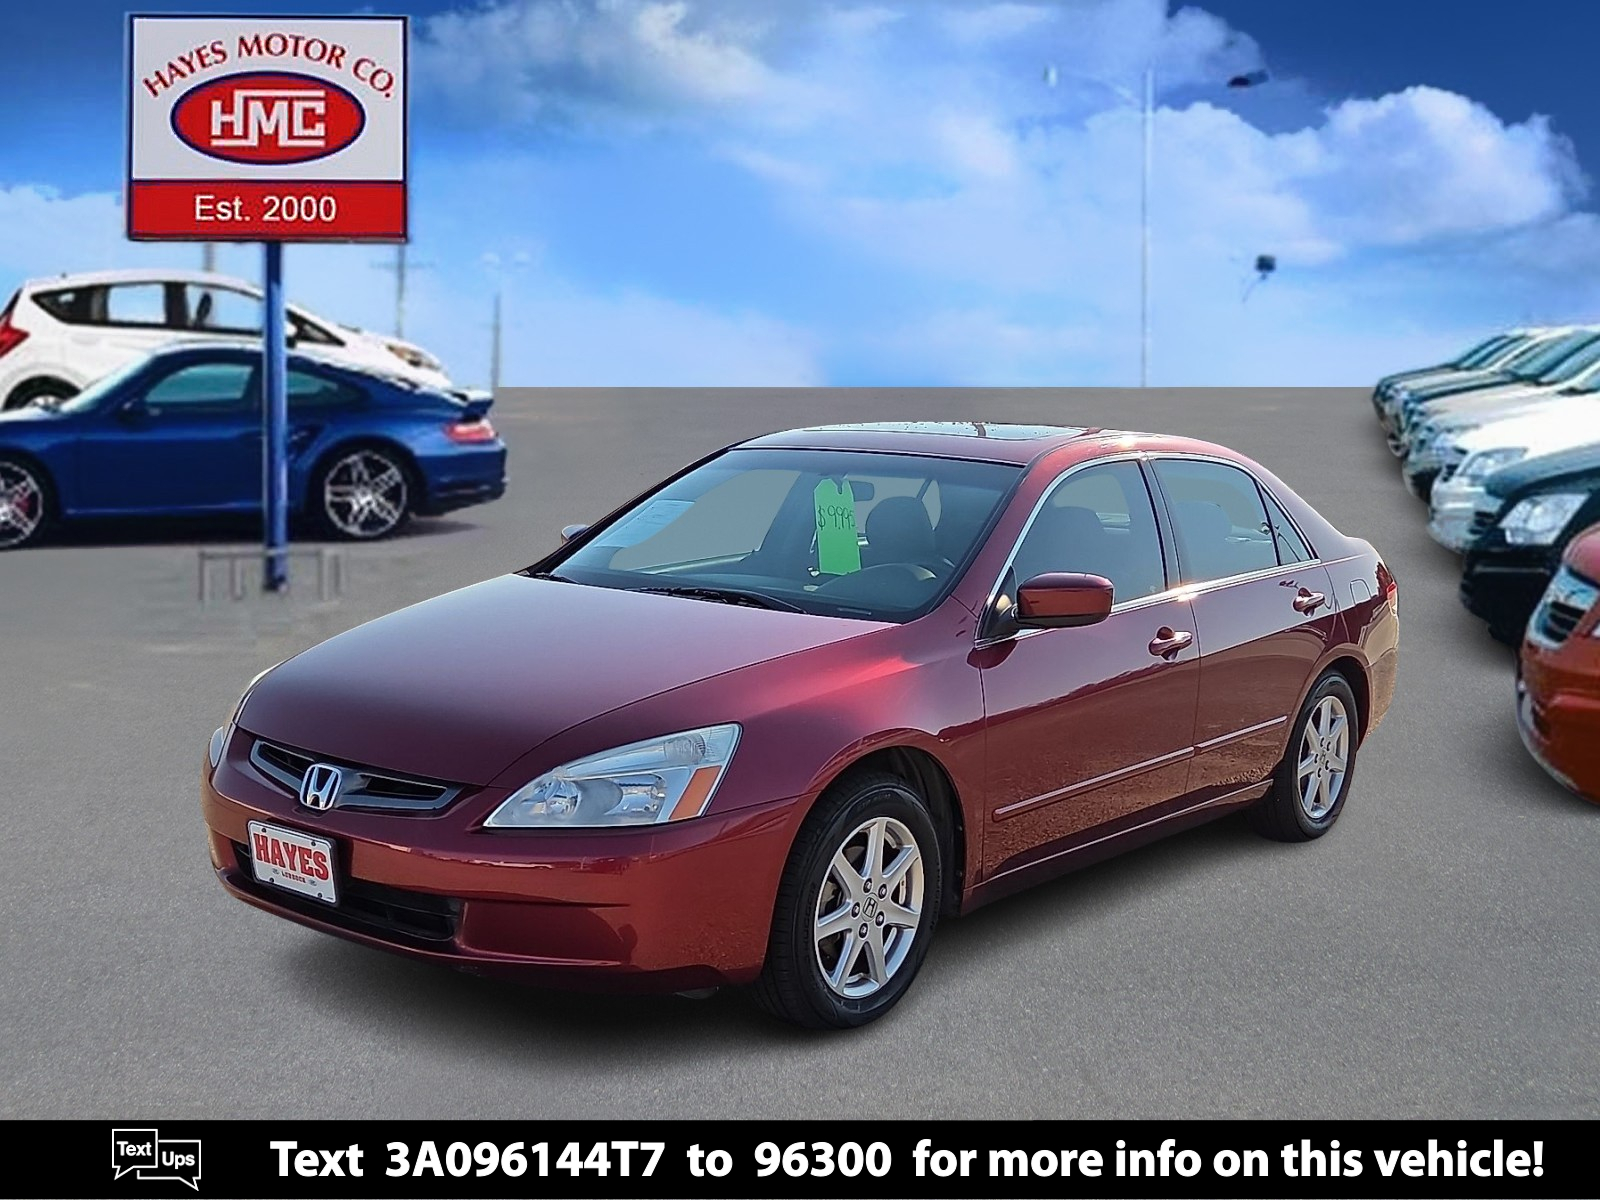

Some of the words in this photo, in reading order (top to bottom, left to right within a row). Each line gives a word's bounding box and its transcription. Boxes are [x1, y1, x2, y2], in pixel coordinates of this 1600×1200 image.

[142, 40, 227, 97] HAYES
[237, 33, 346, 69] MOTOR
[353, 57, 395, 98] CO.
[211, 89, 326, 147] HMC
[195, 195, 250, 221] Est.
[262, 195, 337, 222] 2000
[253, 833, 329, 881] HAYES
